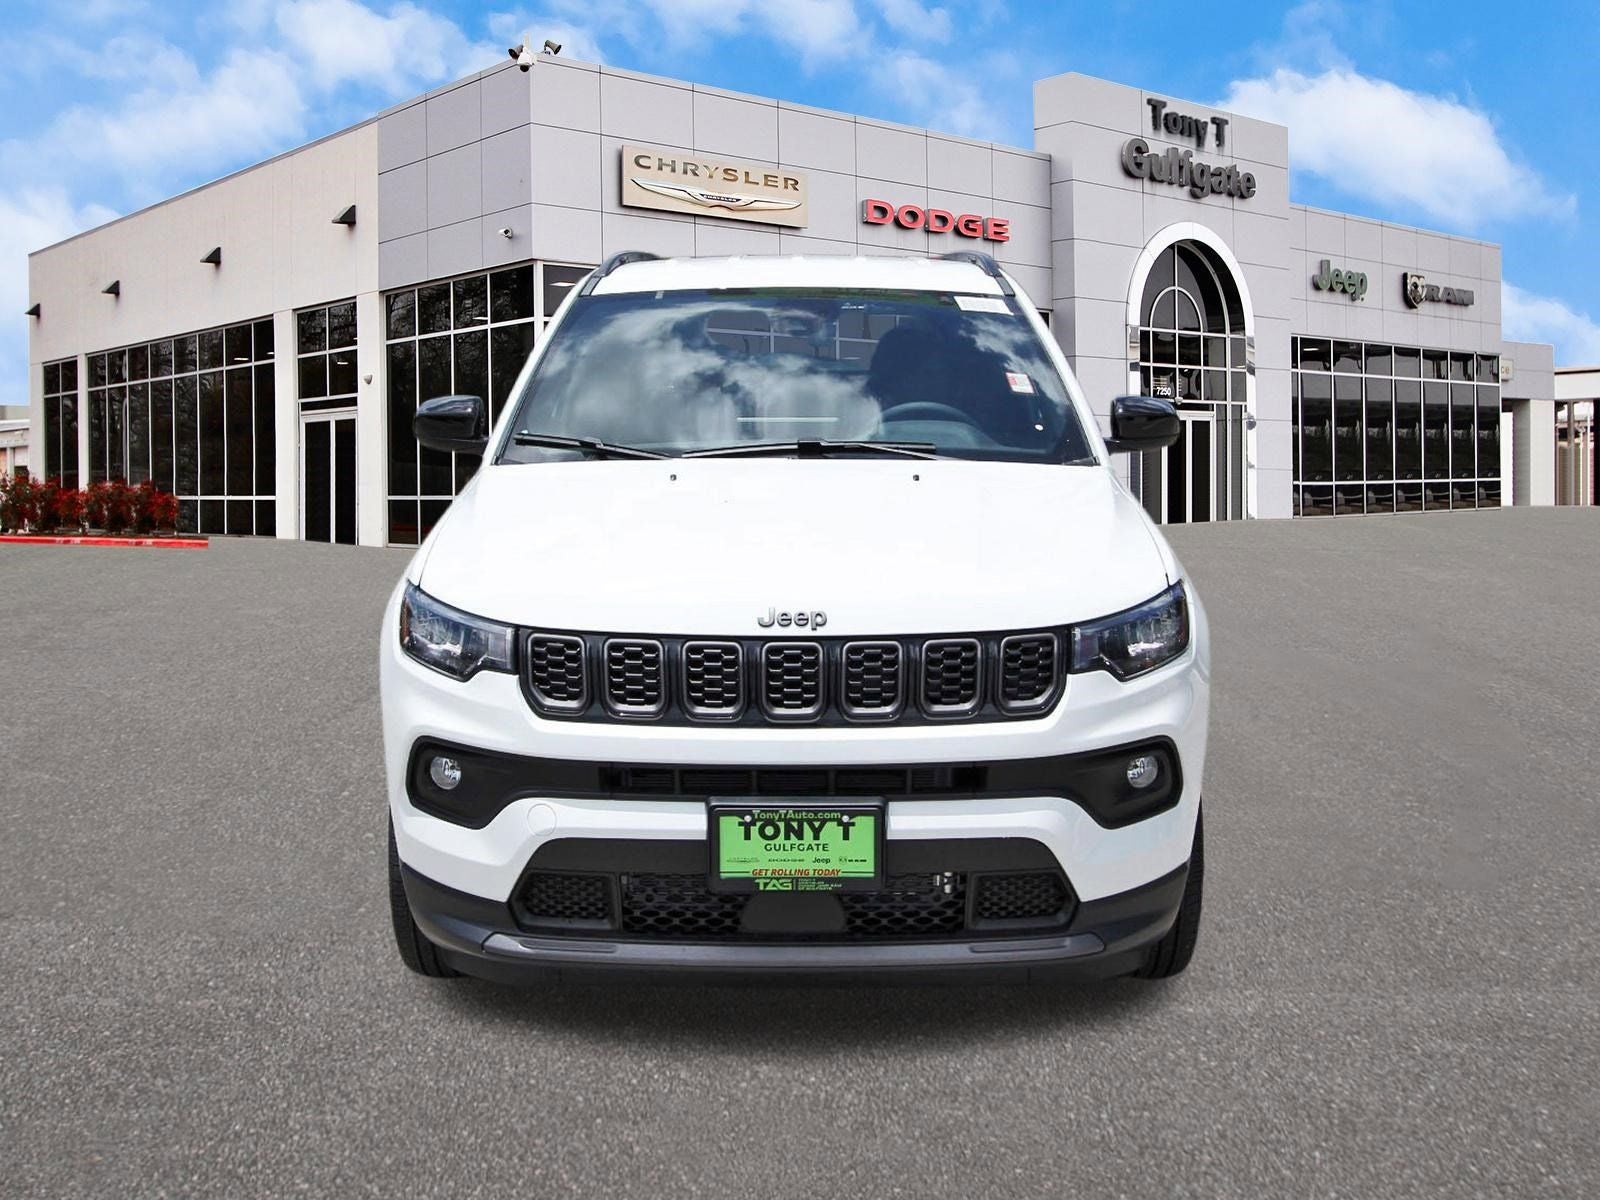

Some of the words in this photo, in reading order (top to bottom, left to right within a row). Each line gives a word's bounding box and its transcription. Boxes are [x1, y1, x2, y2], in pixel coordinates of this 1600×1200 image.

[1147, 98, 1208, 147] Tony
[1211, 116, 1229, 147] T
[634, 154, 799, 191] CHRYSLER
[1121, 138, 1256, 198] Gulfgate
[863, 199, 1010, 242] DODGE
[1313, 260, 1368, 302] Jeep
[1425, 283, 1475, 307] RAM
[1156, 386, 1172, 396] 7250
[757, 607, 828, 631] Jeep
[752, 809, 841, 820] TonyTAuto.com
[738, 820, 828, 841] TONY
[837, 820, 856, 841] T
[764, 843, 830, 852] GULFGATE
[812, 857, 831, 865] Jeep
[752, 868, 770, 877] GET
[771, 868, 810, 877] ROLLING
[812, 868, 841, 877] TODAY
[754, 878, 793, 891] TAG
